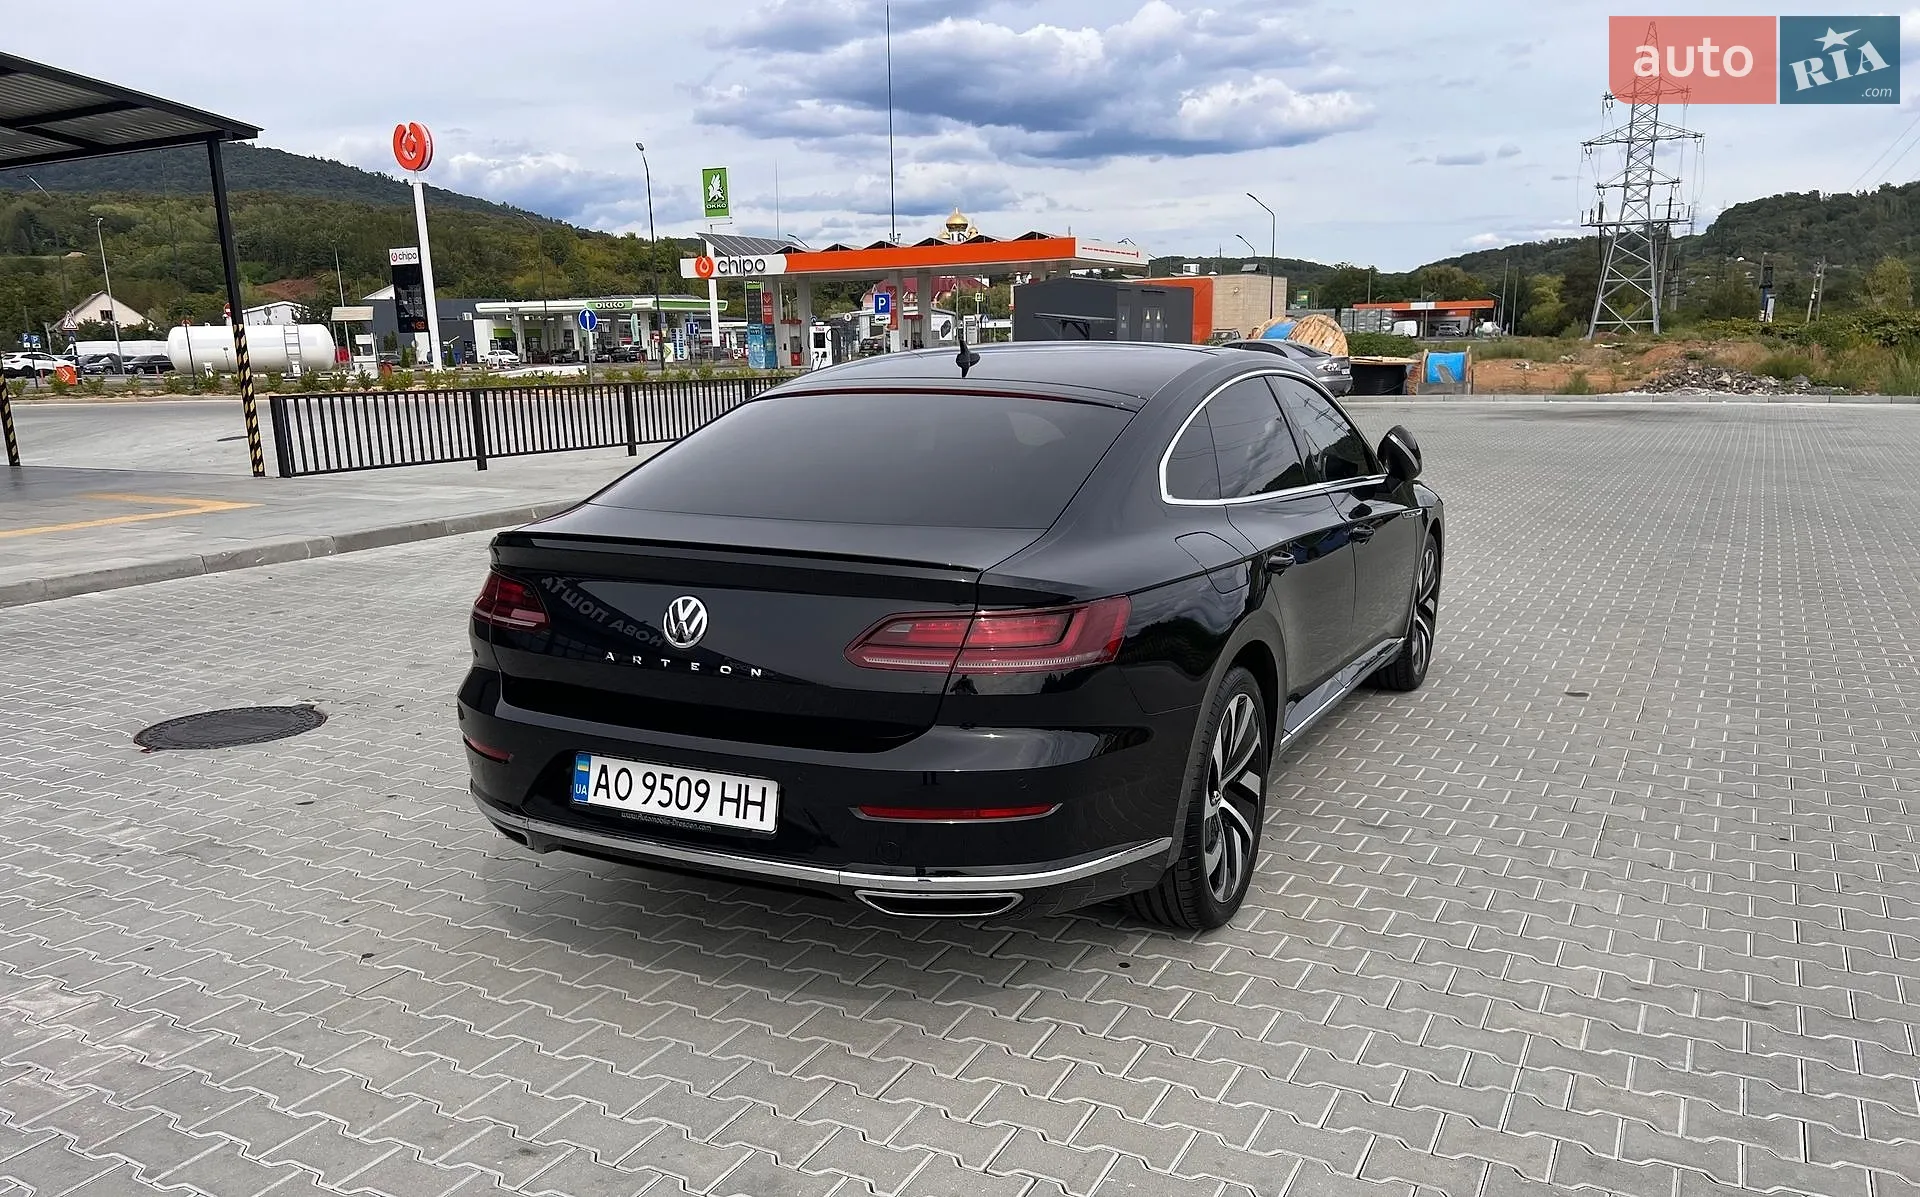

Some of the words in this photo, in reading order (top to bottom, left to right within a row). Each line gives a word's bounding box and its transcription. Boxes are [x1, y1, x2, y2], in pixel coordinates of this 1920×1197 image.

[398, 251, 417, 260] chipo
[717, 256, 766, 277] chipo
[595, 301, 625, 309] OKKO
[605, 652, 762, 677] ARTEON
[575, 783, 588, 796] UA
[593, 764, 633, 801] AO
[641, 771, 711, 813] 9509
[718, 781, 767, 822] HH
